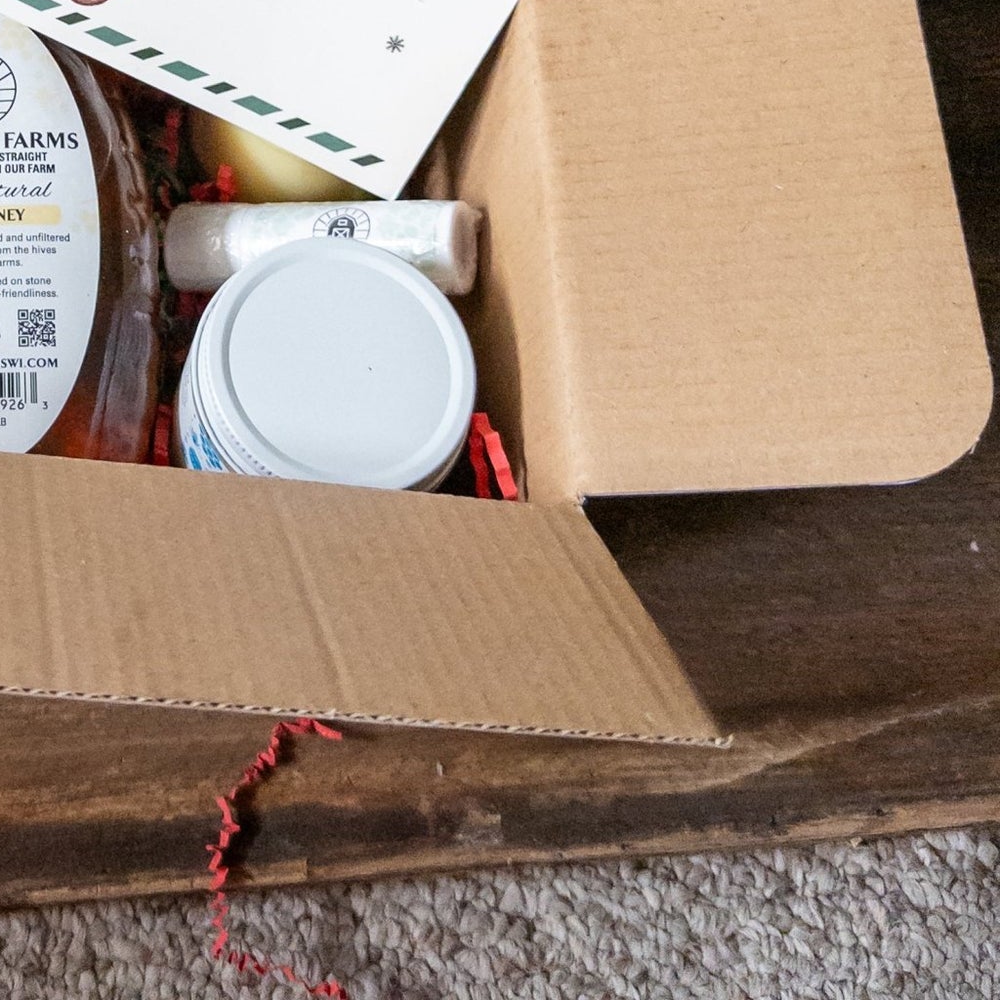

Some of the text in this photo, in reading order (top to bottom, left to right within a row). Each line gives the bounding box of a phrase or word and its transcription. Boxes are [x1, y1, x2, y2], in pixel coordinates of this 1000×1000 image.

[4, 132, 79, 149] FARMS
[0, 152, 48, 162] STRAIGHT
[5, 164, 25, 173] OUR
[28, 164, 55, 173] FARM
[6, 233, 24, 242] and
[26, 233, 70, 242] unfiltered
[14, 246, 29, 254] the
[32, 246, 57, 254] hives
[11, 278, 23, 286] on
[25, 277, 51, 285] stone
[42, 401, 48, 410] 3
